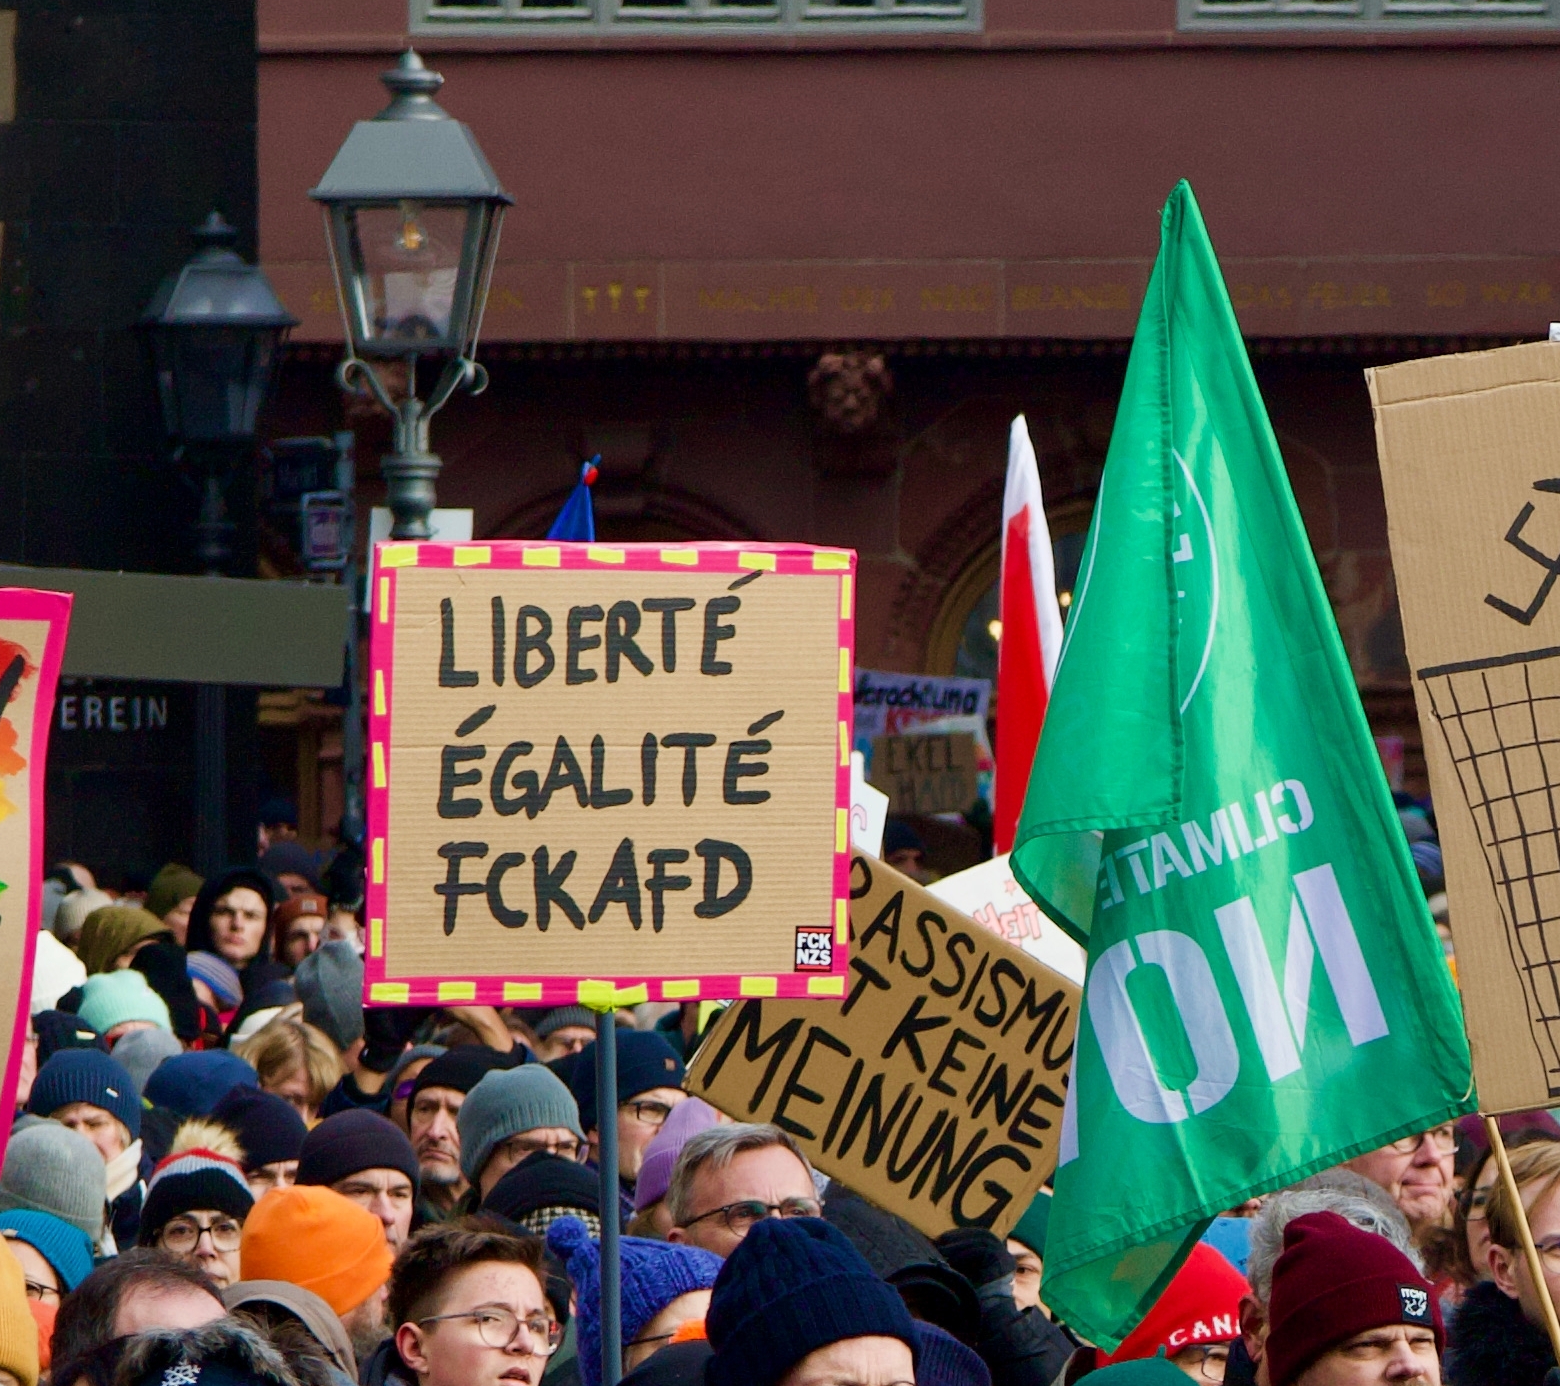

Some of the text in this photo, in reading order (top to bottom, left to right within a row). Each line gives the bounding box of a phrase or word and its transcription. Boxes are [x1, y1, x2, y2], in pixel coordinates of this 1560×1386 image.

[438, 568, 764, 689] LIBERTÉ
[58, 694, 168, 732] EREIN
[436, 703, 786, 820] ÉGALITÉ
[796, 932, 832, 951] FCK
[796, 949, 832, 966] NZS
[848, 856, 1076, 1088] ASSISMU
[700, 999, 1032, 1229] MEINUNG
[880, 994, 1065, 1150] KEINE
